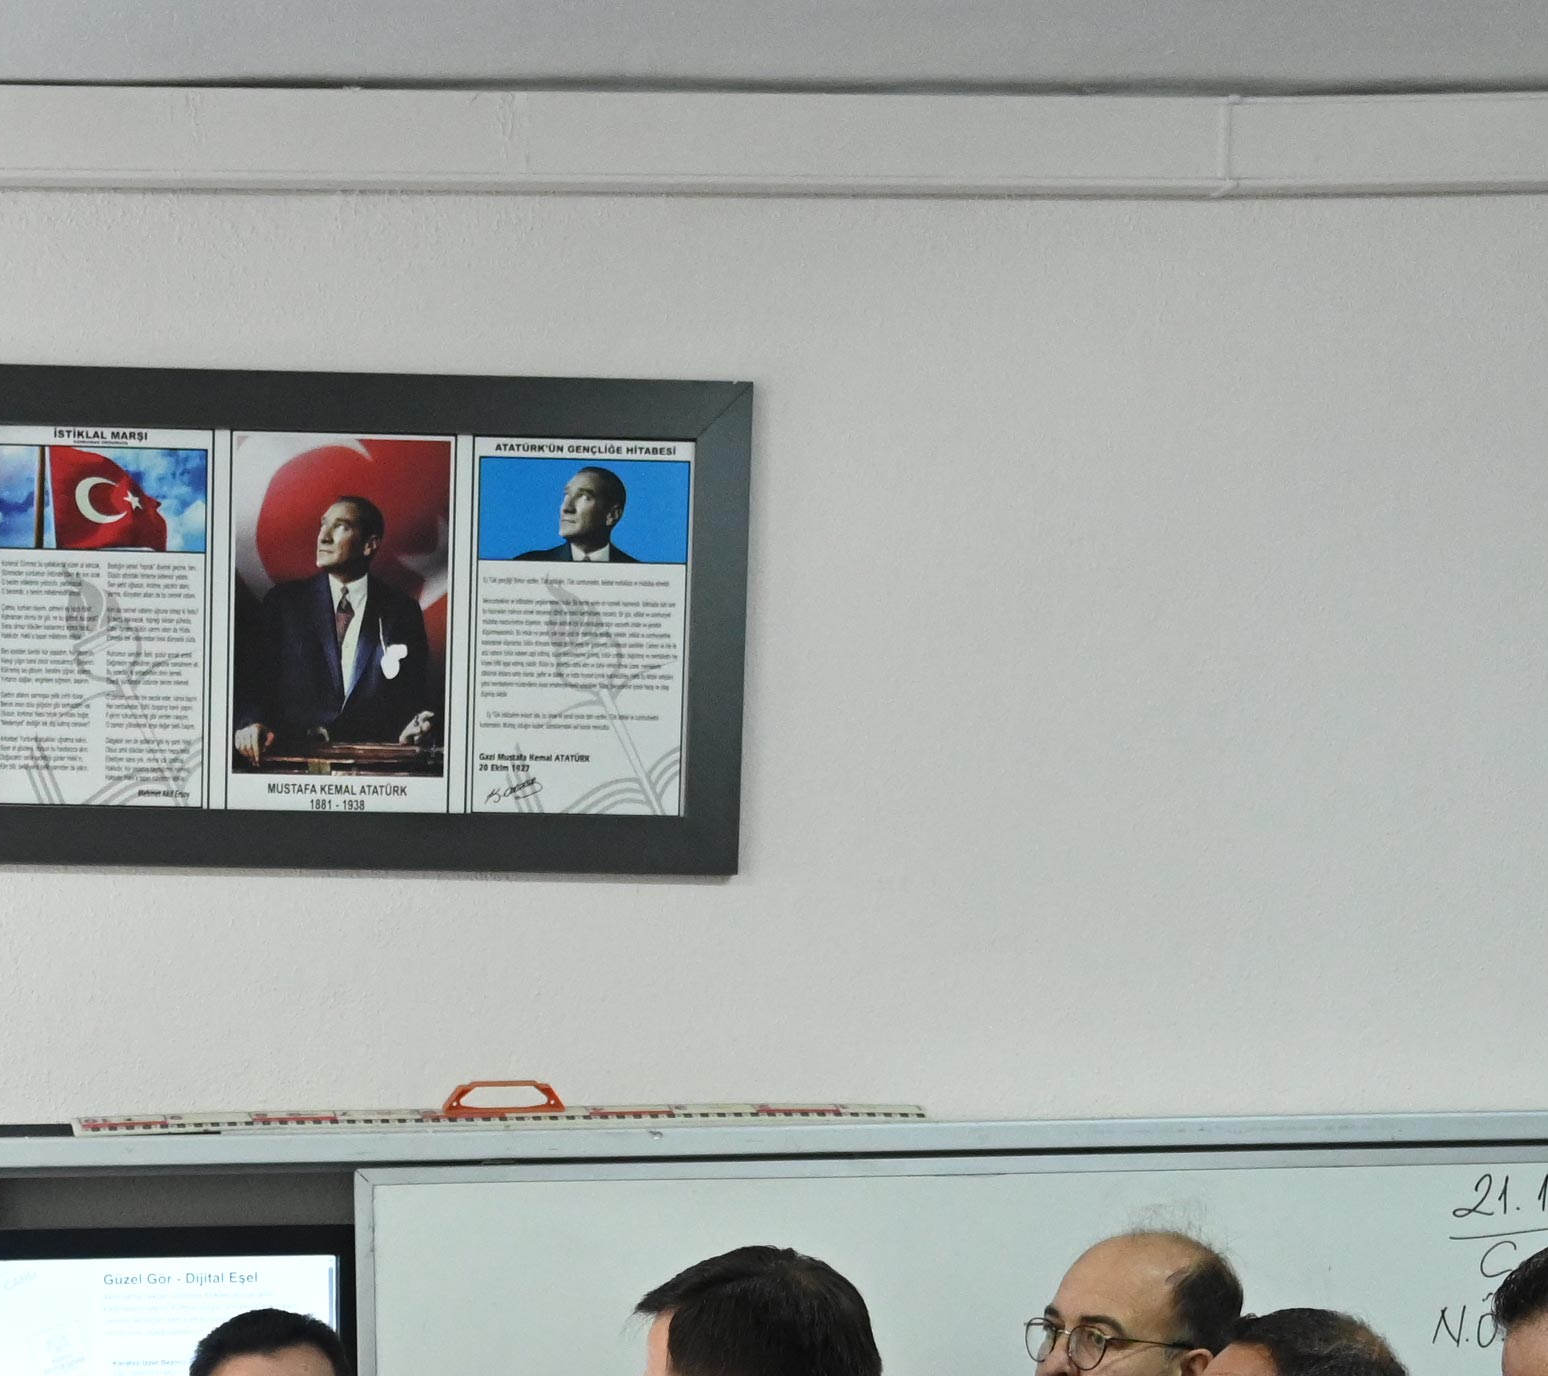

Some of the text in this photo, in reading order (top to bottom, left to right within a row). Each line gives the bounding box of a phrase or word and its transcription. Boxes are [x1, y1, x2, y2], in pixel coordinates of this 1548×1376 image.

[54, 427, 148, 441] İSTİKLAL MARŞI
[495, 443, 676, 456] ATATÜRK'ÜN GENÇLİĞE HİTABESİ
[479, 752, 590, 763] Gazi Mustafa Kemal ATATÜRK
[479, 764, 489, 772] 20
[491, 764, 509, 772] Ekim
[267, 783, 408, 797] MUSTAFA KEMAL ATATÜRK
[310, 799, 332, 810] 1881
[343, 799, 365, 811] 1938
[186, 1272, 224, 1286] Dijital
[229, 1272, 258, 1285] Eşel
